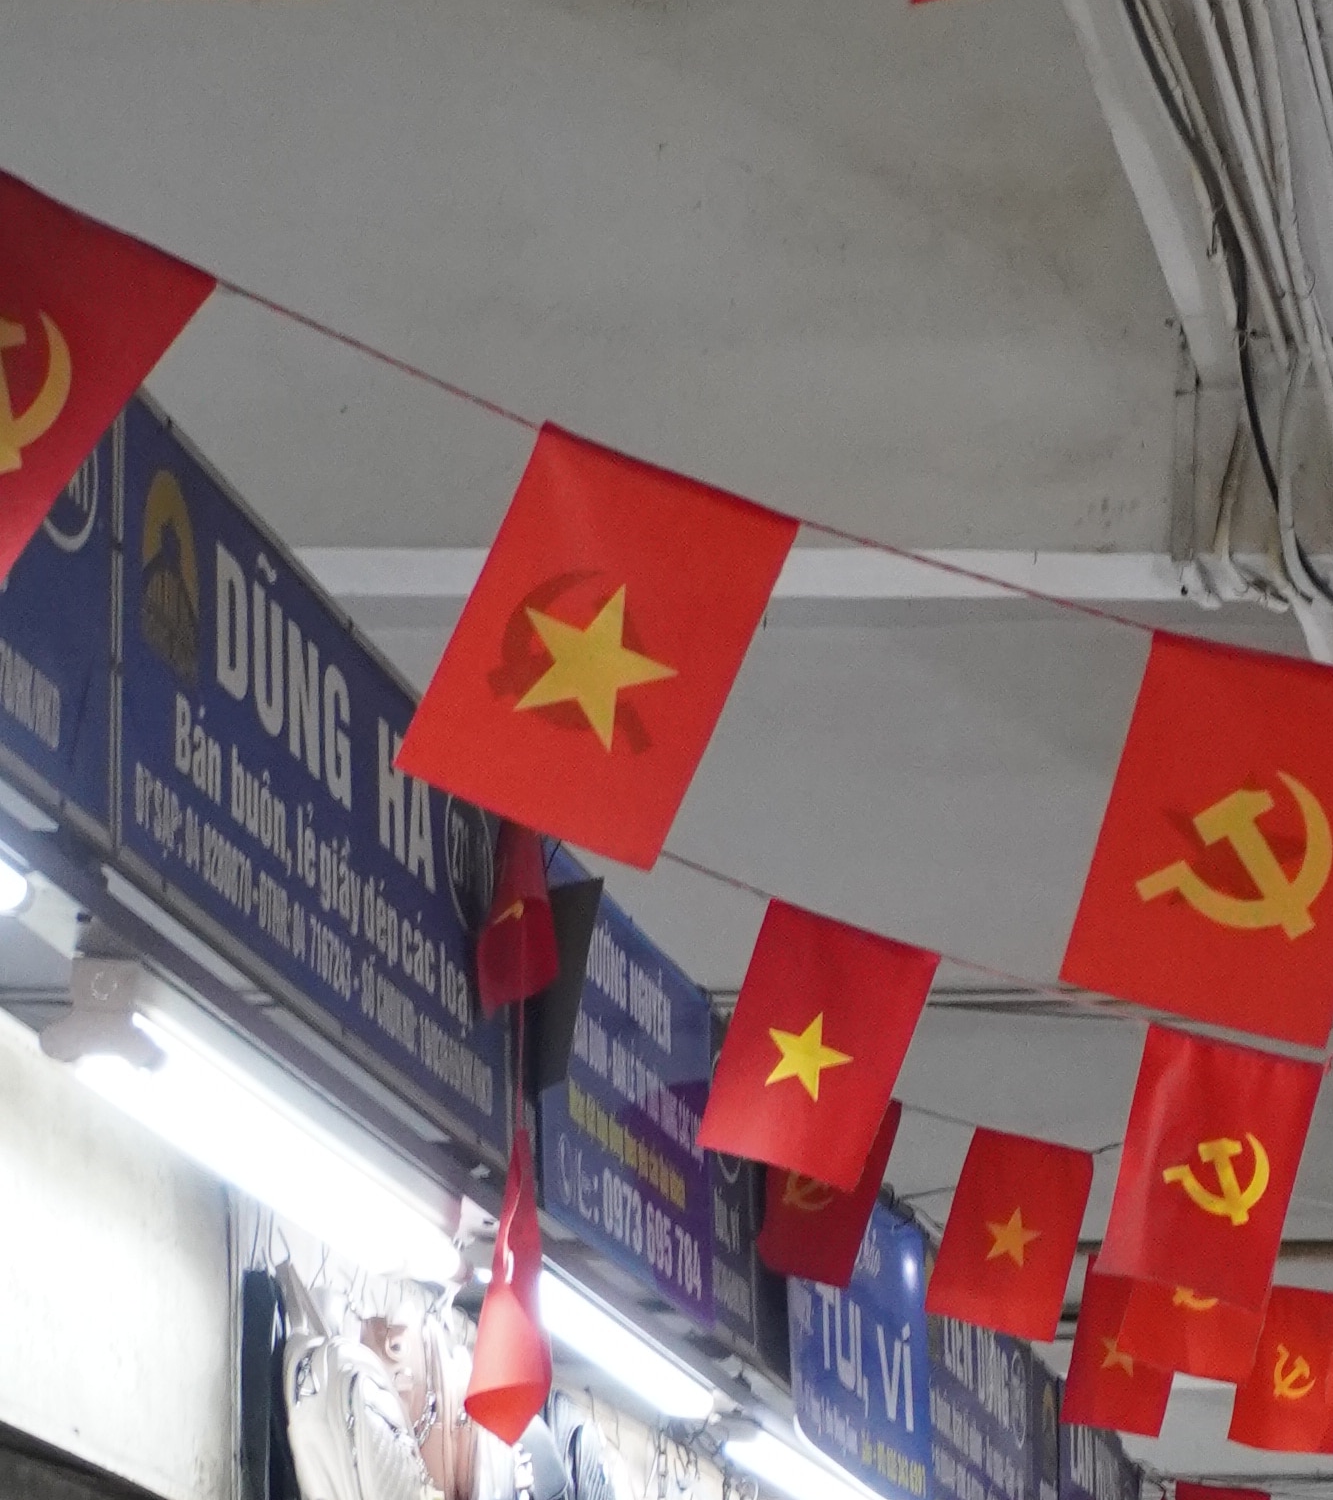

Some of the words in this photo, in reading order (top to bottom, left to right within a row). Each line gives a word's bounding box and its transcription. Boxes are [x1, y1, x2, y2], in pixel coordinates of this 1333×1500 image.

[216, 541, 352, 812] DŨNG
[175, 691, 221, 806] Bán
[231, 743, 293, 875] buôn,
[363, 875, 398, 966] dép
[401, 910, 435, 996] các
